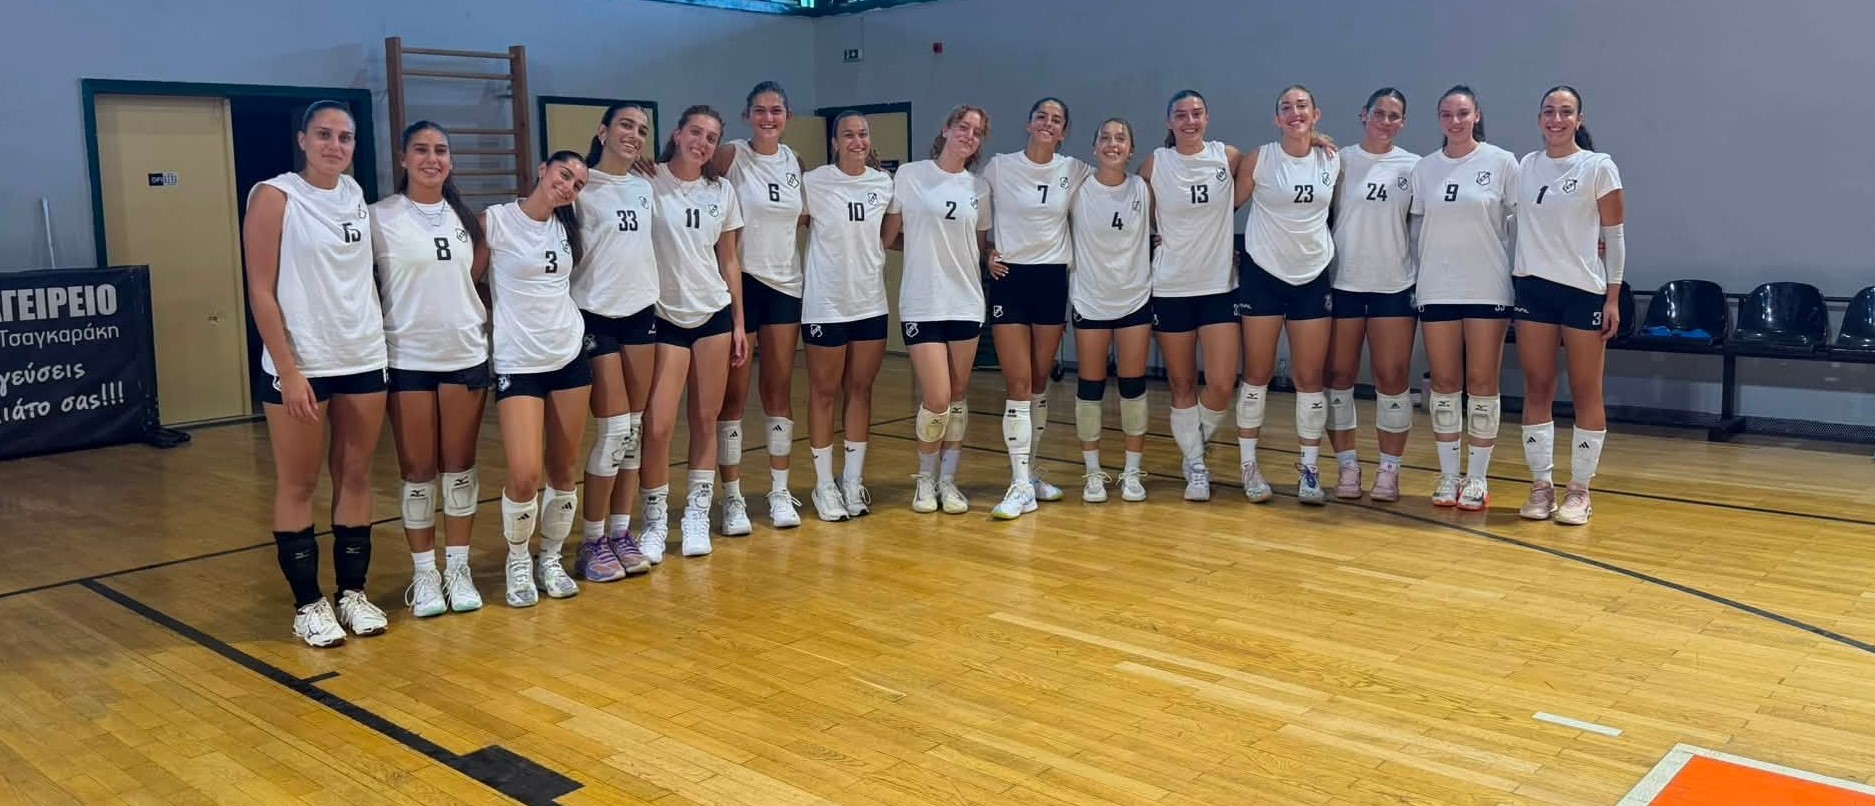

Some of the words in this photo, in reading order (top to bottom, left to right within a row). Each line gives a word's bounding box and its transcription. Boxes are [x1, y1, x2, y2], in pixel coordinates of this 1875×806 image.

[767, 183, 780, 202] 6
[1037, 185, 1049, 204] 7
[1190, 185, 1209, 204] 13
[1293, 184, 1314, 203] 23
[1366, 183, 1388, 202] 24
[1444, 183, 1459, 202] 9
[1536, 185, 1549, 205] 1
[616, 210, 638, 231] 33
[685, 208, 700, 229] 11
[847, 202, 865, 222] 10
[944, 201, 957, 220] 2
[1111, 211, 1124, 231] 4
[434, 237, 452, 261] 8
[545, 250, 558, 274] 3
[0, 283, 118, 322] ΓΕΙΡΕΙΟ
[0, 398, 51, 424] ιάτο
[61, 380, 124, 412] σας!!!
